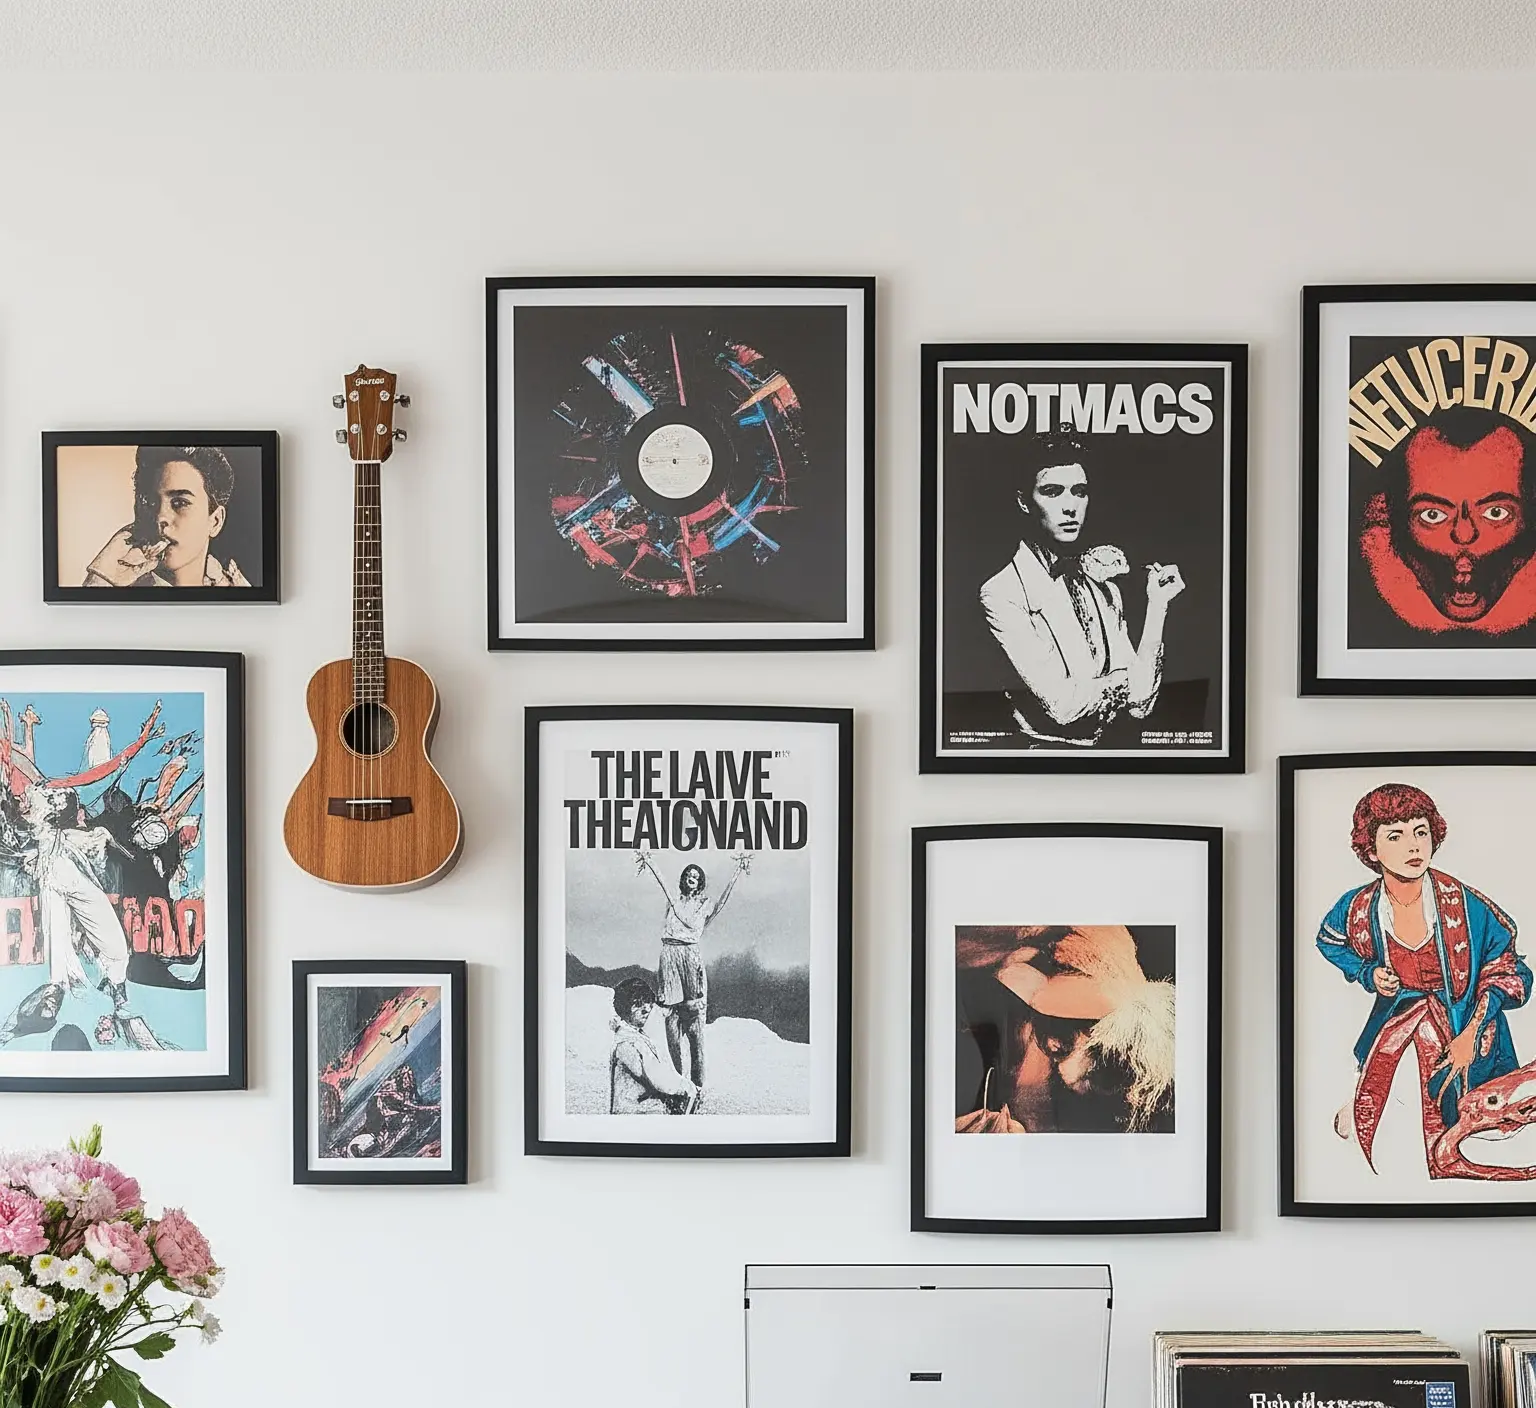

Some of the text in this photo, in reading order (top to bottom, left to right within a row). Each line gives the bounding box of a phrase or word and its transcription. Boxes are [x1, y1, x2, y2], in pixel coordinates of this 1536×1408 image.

[953, 382, 1214, 435] NOTMACS
[591, 750, 773, 800] THE LAIVE
